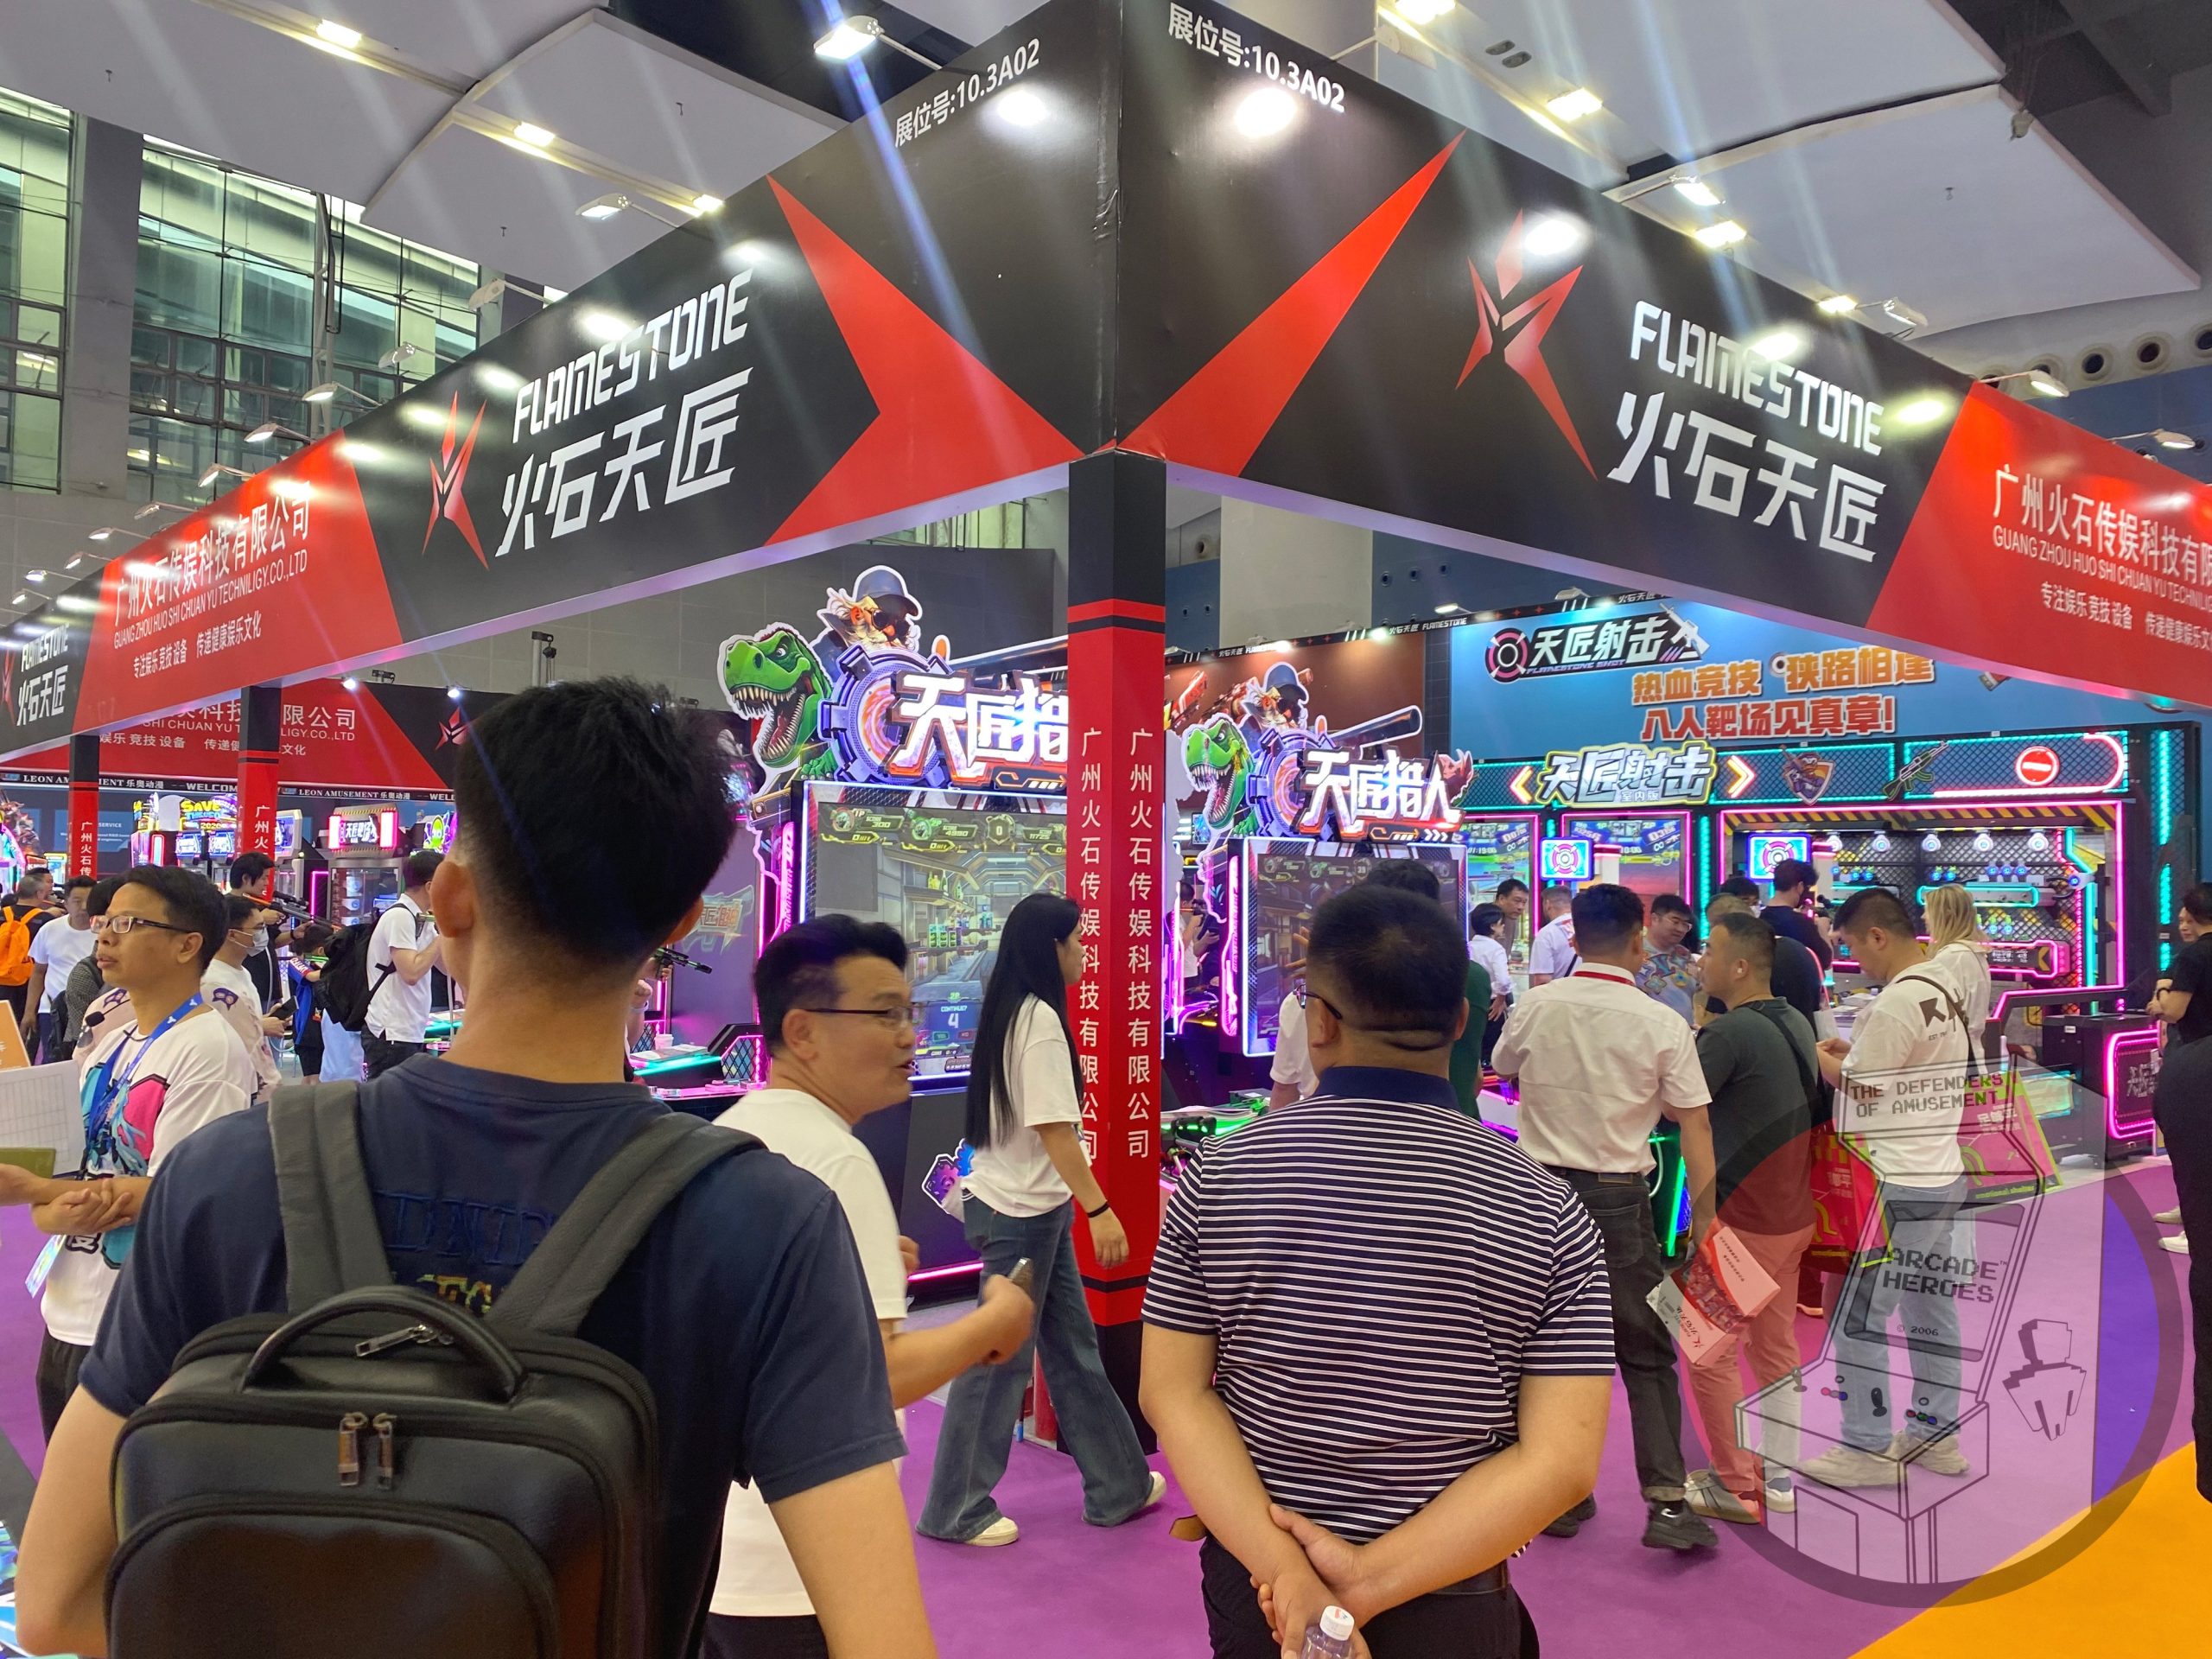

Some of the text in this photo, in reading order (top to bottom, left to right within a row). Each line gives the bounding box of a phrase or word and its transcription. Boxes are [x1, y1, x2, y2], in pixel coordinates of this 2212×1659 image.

[1168, 2, 1345, 112] 展位号:10.3A02
[895, 38, 1039, 148] 展位号:10.3A02
[512, 268, 753, 443] FLAMESTONE
[1630, 300, 1884, 455] FLAMESTONE
[495, 367, 753, 557] 火石天匠
[1606, 390, 1886, 563] 火石天匠
[1993, 524, 2037, 558] GUANG
[2039, 540, 2071, 569] ZHOU
[2073, 551, 2097, 576] HUO
[2099, 559, 2116, 582] SHI
[2117, 565, 2152, 594] CHUAN
[2153, 576, 2167, 598] YU
[114, 624, 135, 650] GUANG
[135, 618, 153, 639] ZHOU
[153, 614, 168, 633] HUO
[168, 608, 180, 627] SHI
[181, 595, 206, 620] CHUAN
[207, 589, 217, 608] YU
[1389, 618, 1467, 634] 火石天匠 FLAMESTONE
[1530, 615, 1669, 667] 天匠射击
[1527, 659, 1625, 674] FLAMESTONE SHOT
[1632, 645, 1935, 703] 热血竞技 狭路相逢
[16, 664, 68, 726] 火石天匠
[1642, 695, 1896, 741] 八人靶场见真章!
[168, 719, 213, 731] CHUAN
[215, 722, 232, 733] YU
[23, 775, 54, 784] LEON
[324, 790, 378, 798] AMUSEMENT
[1538, 746, 1711, 802] 天匠射击
[181, 800, 221, 812] SAVE
[254, 805, 270, 855] 广州火
[79, 821, 93, 876] 广州火石传
[1128, 728, 1154, 1158] 广州火石传娱科技有限公司
[948, 1013, 959, 1028] 4
